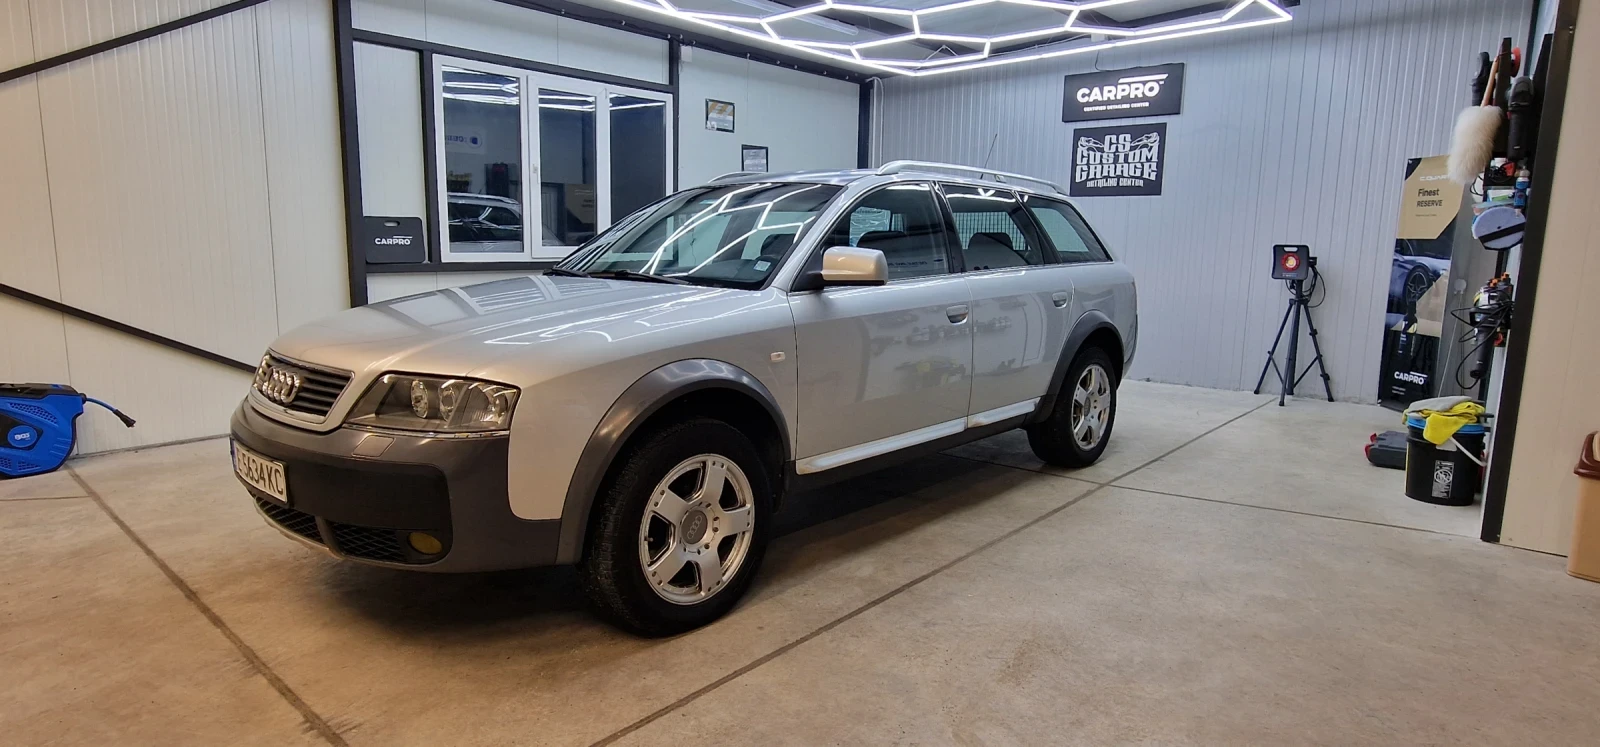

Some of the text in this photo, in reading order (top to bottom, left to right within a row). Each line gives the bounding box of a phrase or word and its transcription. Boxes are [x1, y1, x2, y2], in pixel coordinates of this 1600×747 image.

[1076, 80, 1160, 103] CARPRO
[1103, 133, 1132, 153] CS
[1076, 144, 1159, 165] CUSTOM
[1075, 162, 1158, 183] GARAGE
[1086, 177, 1144, 188] DETAILING CENTER
[1417, 188, 1440, 197] Finest
[1416, 199, 1443, 207] RESERVE
[374, 237, 411, 245] CARPRO
[1394, 371, 1425, 386] CARPRO
